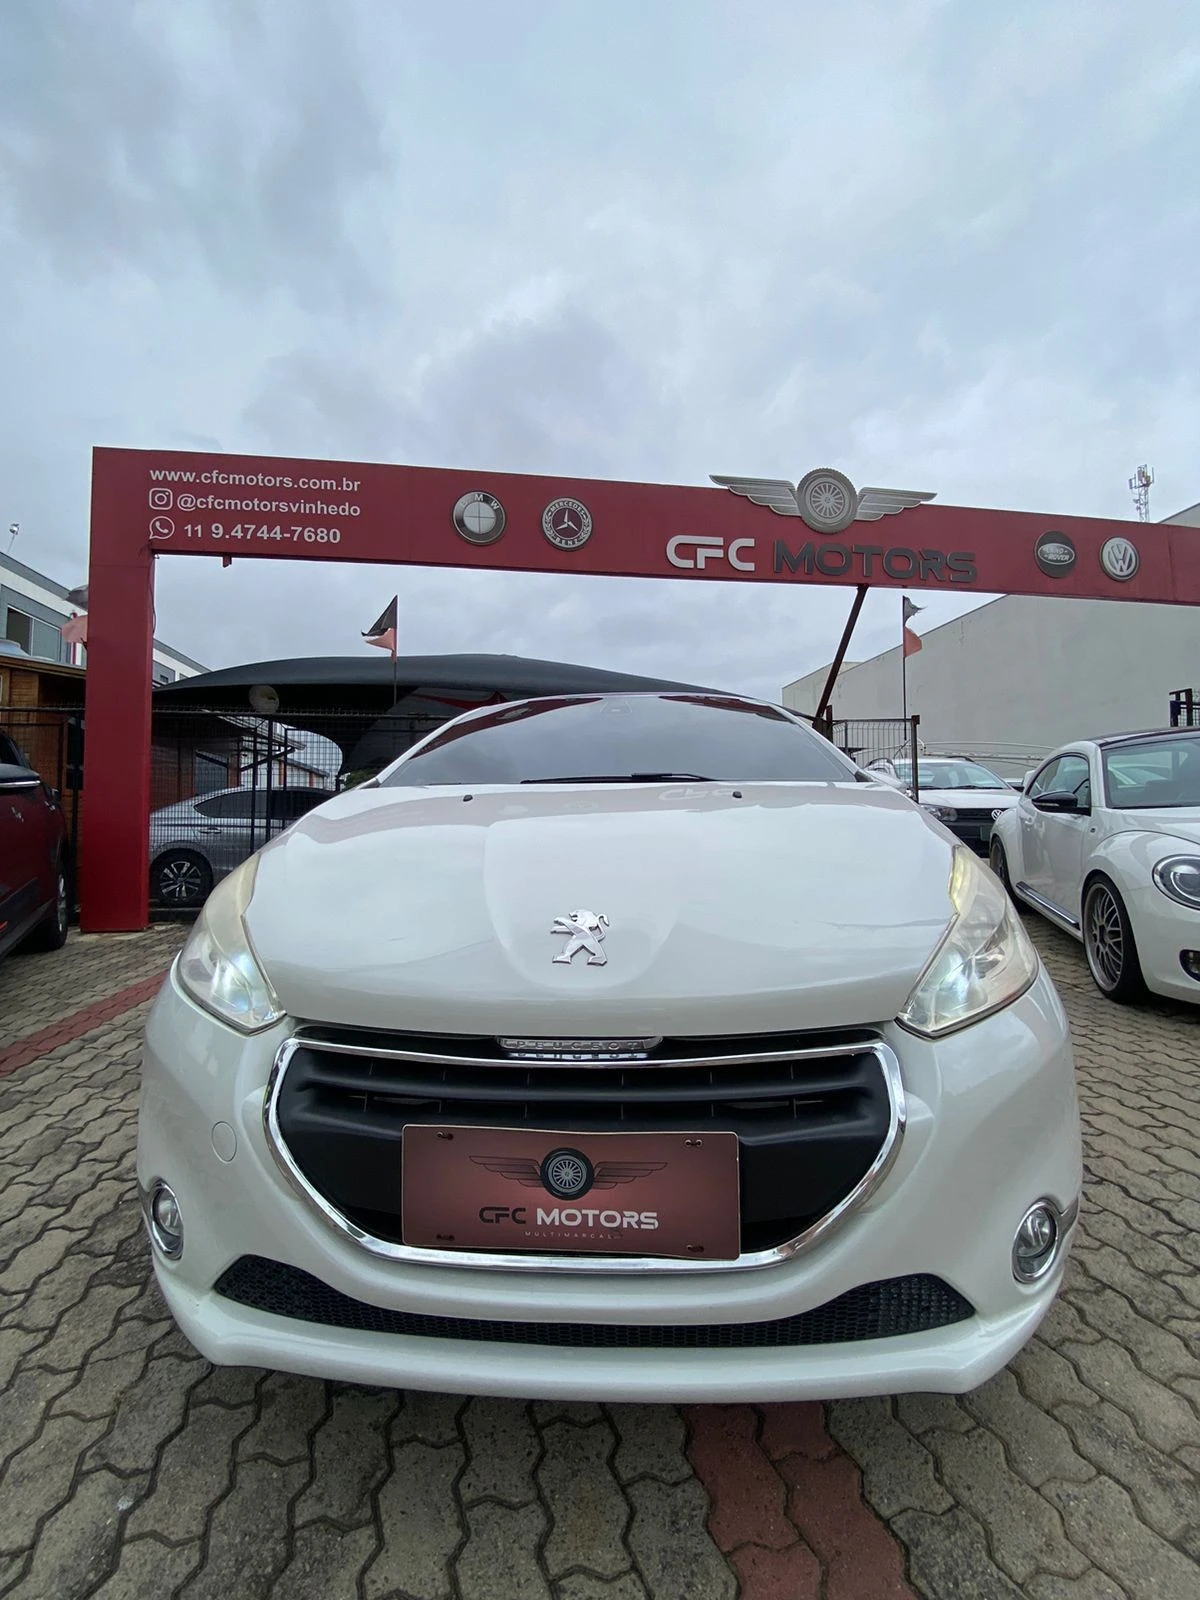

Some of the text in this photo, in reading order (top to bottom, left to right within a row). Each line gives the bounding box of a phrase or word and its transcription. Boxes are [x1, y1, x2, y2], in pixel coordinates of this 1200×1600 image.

[150, 469, 361, 492] www.cfcmotors.com.br
[177, 493, 361, 517] @cfcmotorsvinhedo
[460, 493, 500, 510] BMW
[550, 501, 585, 515] MERCEDES
[184, 522, 341, 544] 11 9.4744-7680
[556, 537, 580, 546] BENZ
[666, 534, 977, 582] CFC MOTORS
[516, 1039, 641, 1050] PEUGEOT
[479, 1206, 659, 1230] CFC MOTORS
